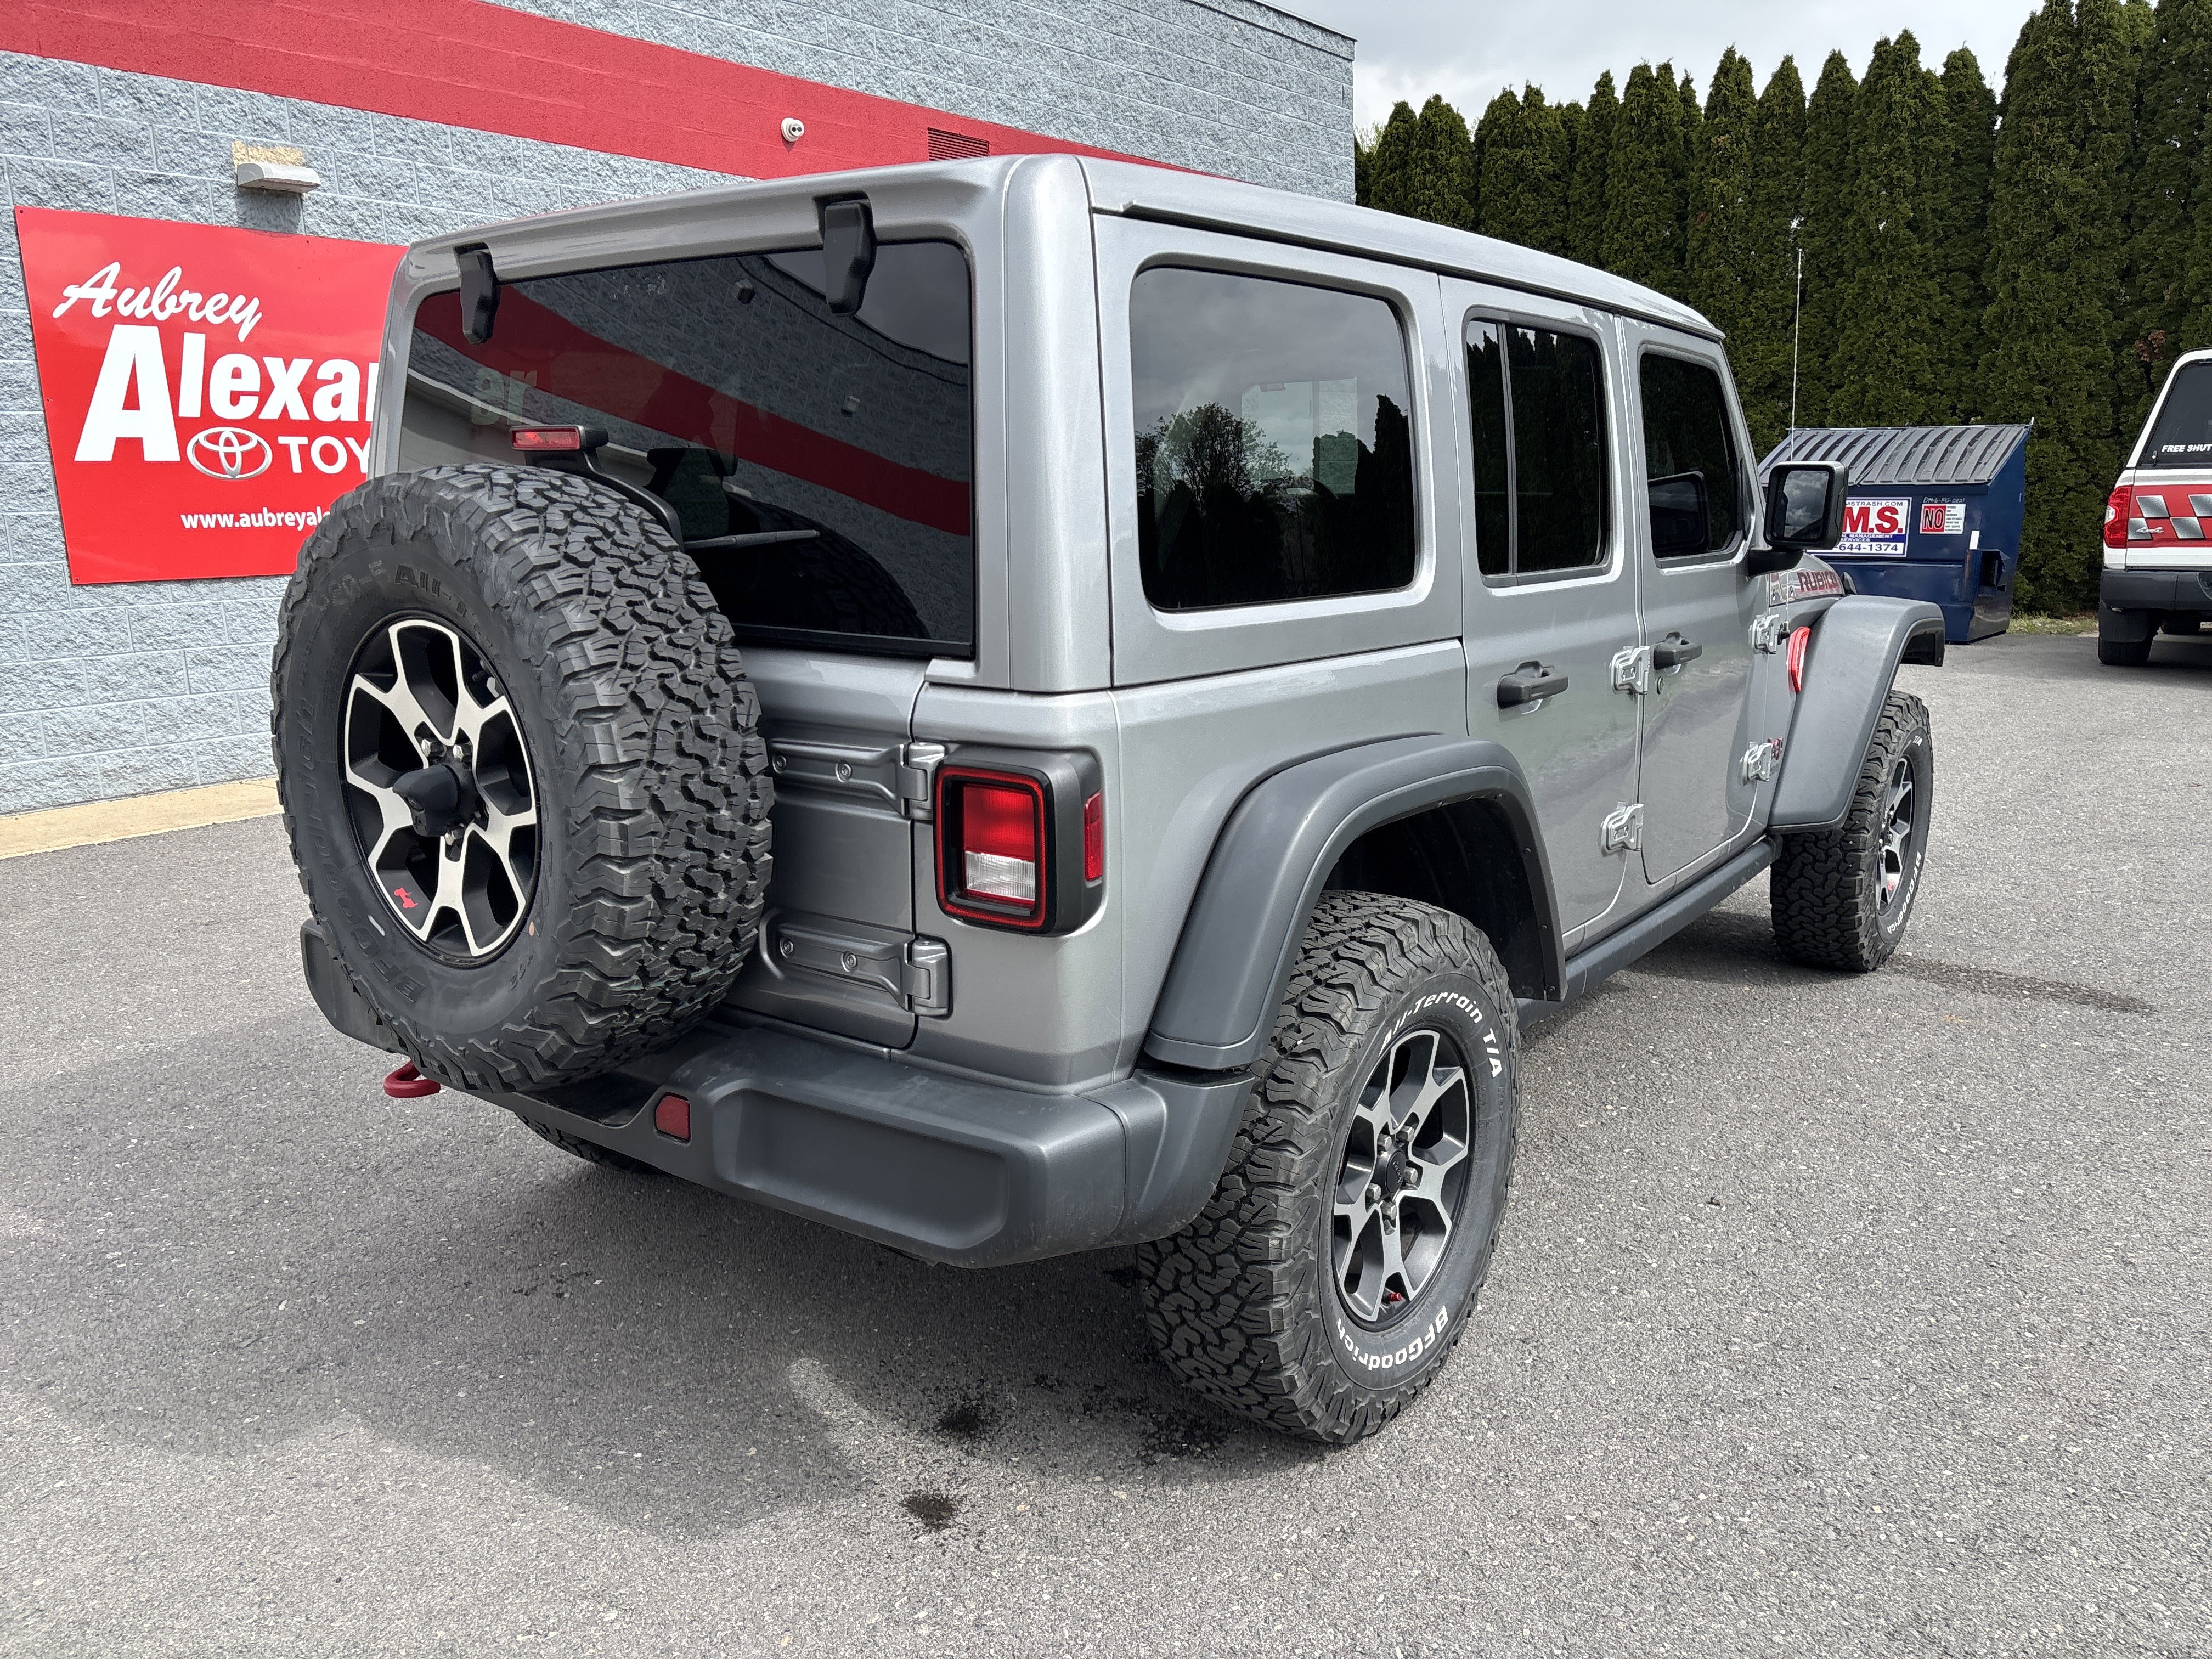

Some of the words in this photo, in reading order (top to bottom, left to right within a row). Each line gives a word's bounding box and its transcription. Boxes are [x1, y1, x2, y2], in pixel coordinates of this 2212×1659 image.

[53, 262, 262, 342] Aubrey
[1922, 507, 1945, 530] NO
[1337, 1304, 1448, 1371] BFGoodrich
